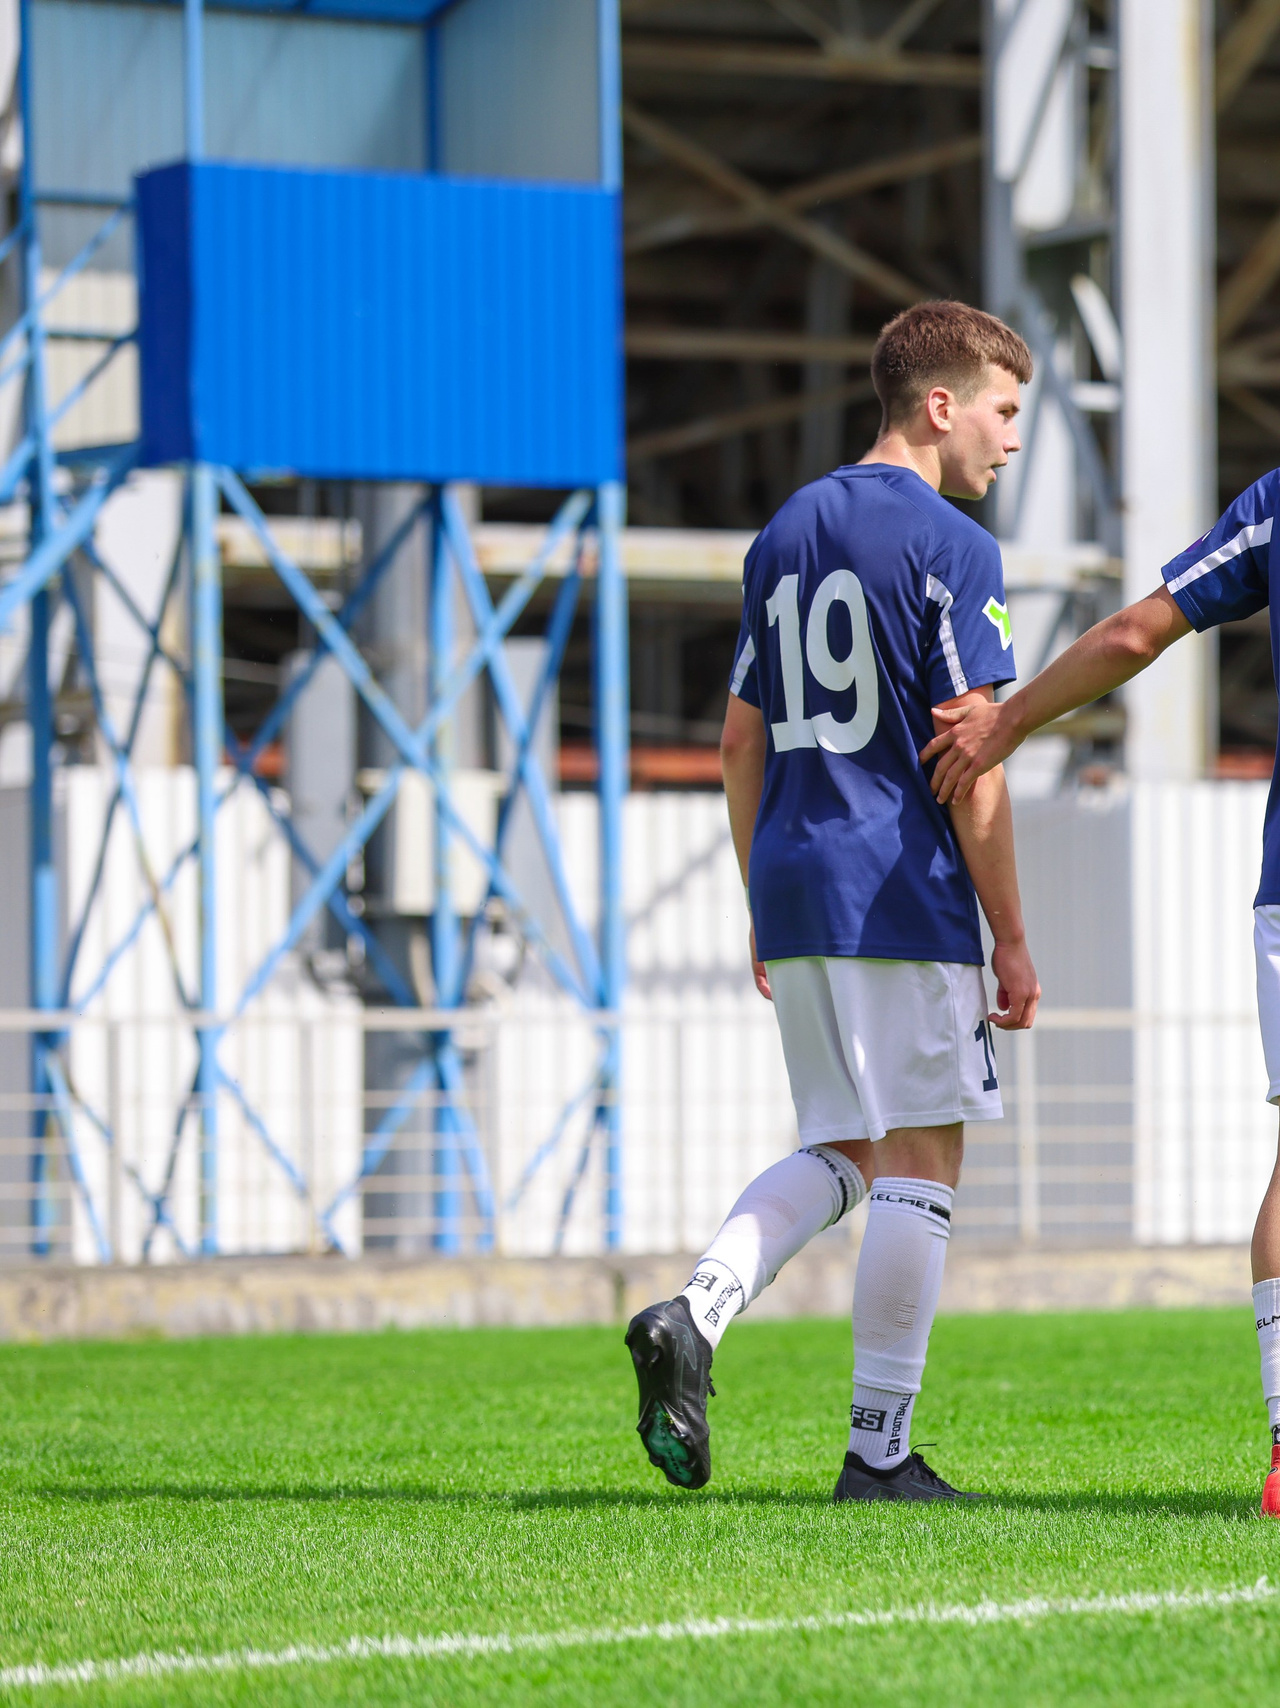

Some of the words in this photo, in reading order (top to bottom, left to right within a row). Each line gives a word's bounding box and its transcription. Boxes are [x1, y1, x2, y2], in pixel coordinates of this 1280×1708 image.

[765, 569, 879, 754] 19
[974, 1019, 998, 1092] 1
[793, 1148, 838, 1175] ELME
[891, 1394, 913, 1437] FOOTBALL
[888, 1440, 899, 1456] FS
